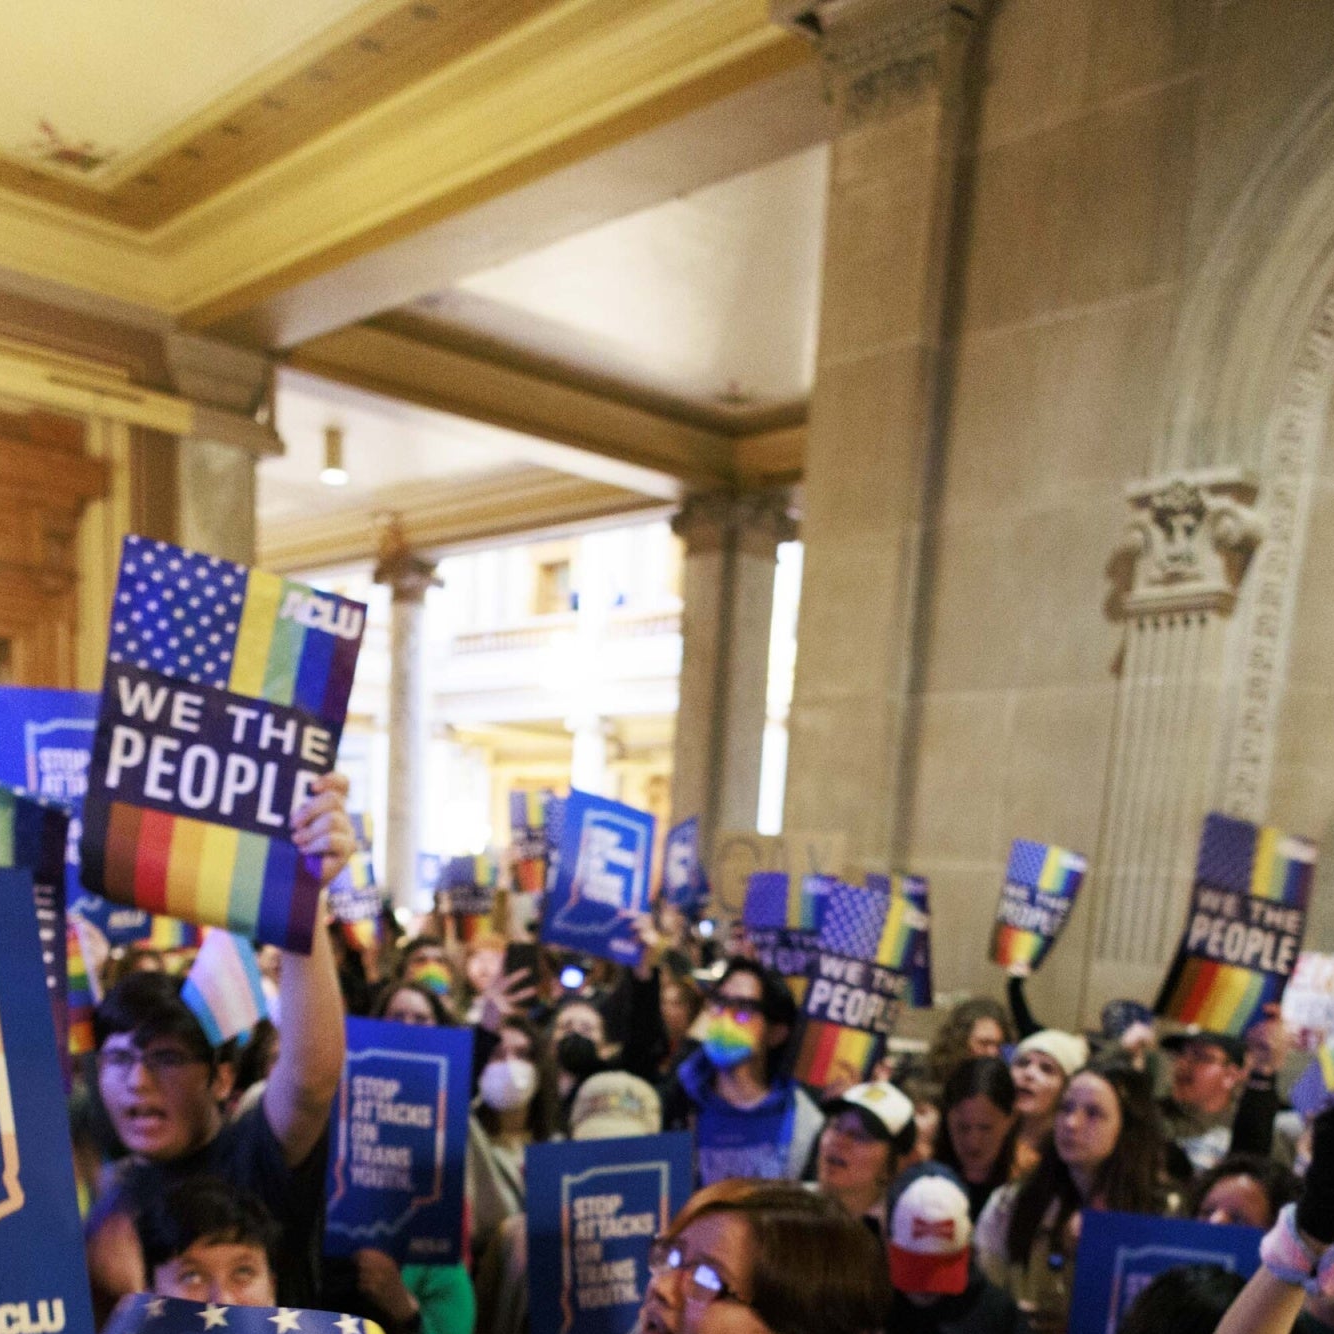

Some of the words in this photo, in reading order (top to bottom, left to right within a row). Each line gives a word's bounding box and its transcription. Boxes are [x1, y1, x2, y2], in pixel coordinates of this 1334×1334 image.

[278, 590, 364, 642] ACLU
[117, 674, 205, 734] WE
[225, 703, 332, 768] THE
[819, 953, 868, 984] WE
[1187, 912, 1299, 977] PEOPLE
